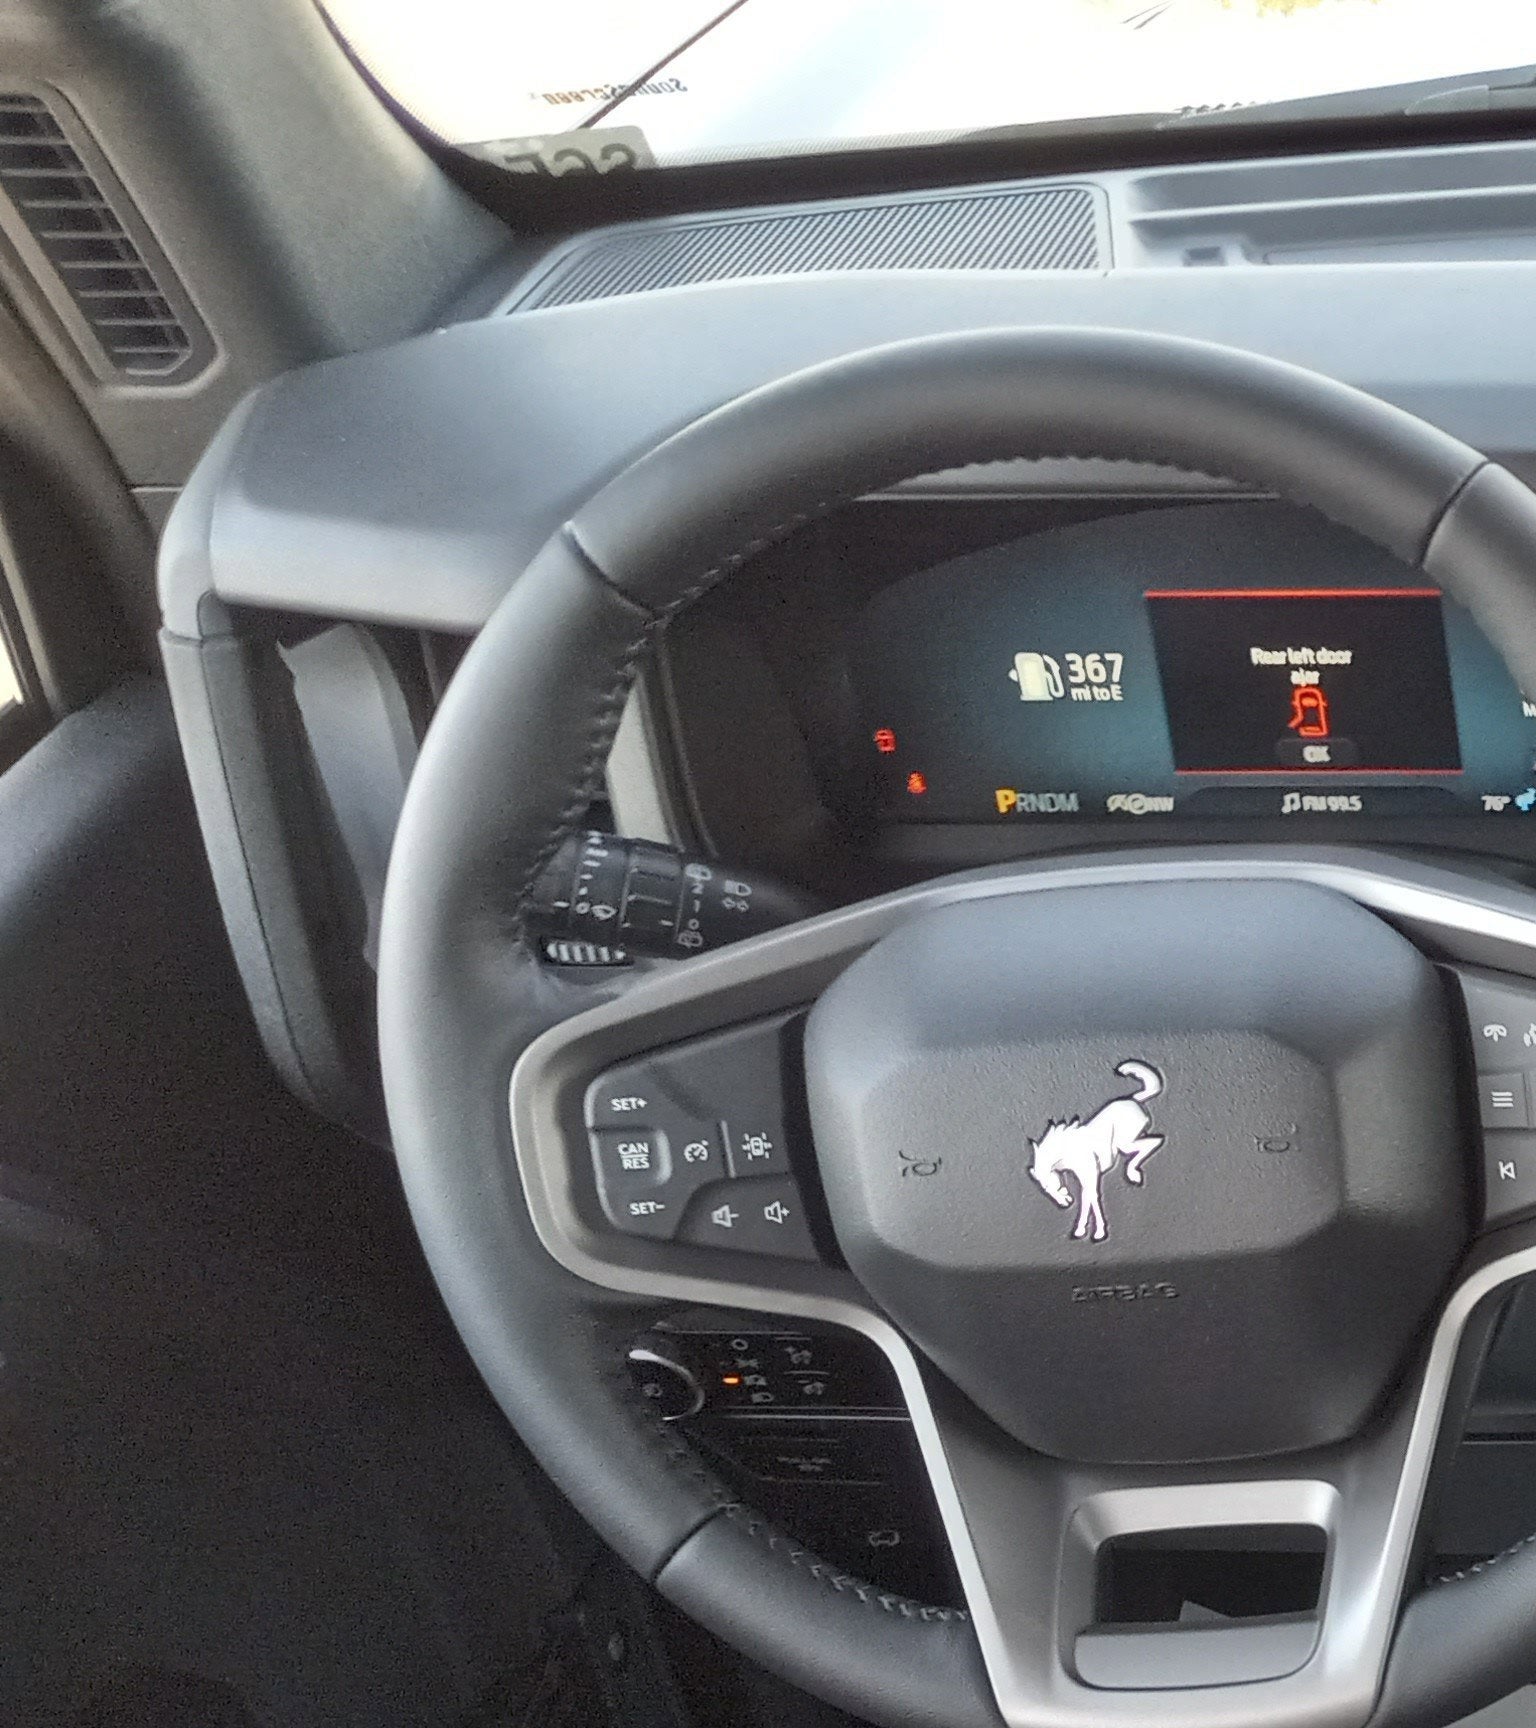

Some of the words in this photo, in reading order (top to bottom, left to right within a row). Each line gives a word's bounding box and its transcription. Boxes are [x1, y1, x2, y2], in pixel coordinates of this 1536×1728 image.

[1250, 647, 1287, 665] Rear
[1287, 647, 1316, 664] left
[1315, 647, 1353, 664] door
[1065, 652, 1124, 683] 367
[1071, 685, 1092, 701] mi
[1093, 685, 1111, 701] to
[1112, 685, 1124, 701] E
[611, 1097, 648, 1111] SET+
[617, 1143, 648, 1155] CAN
[623, 1157, 649, 1170] RES
